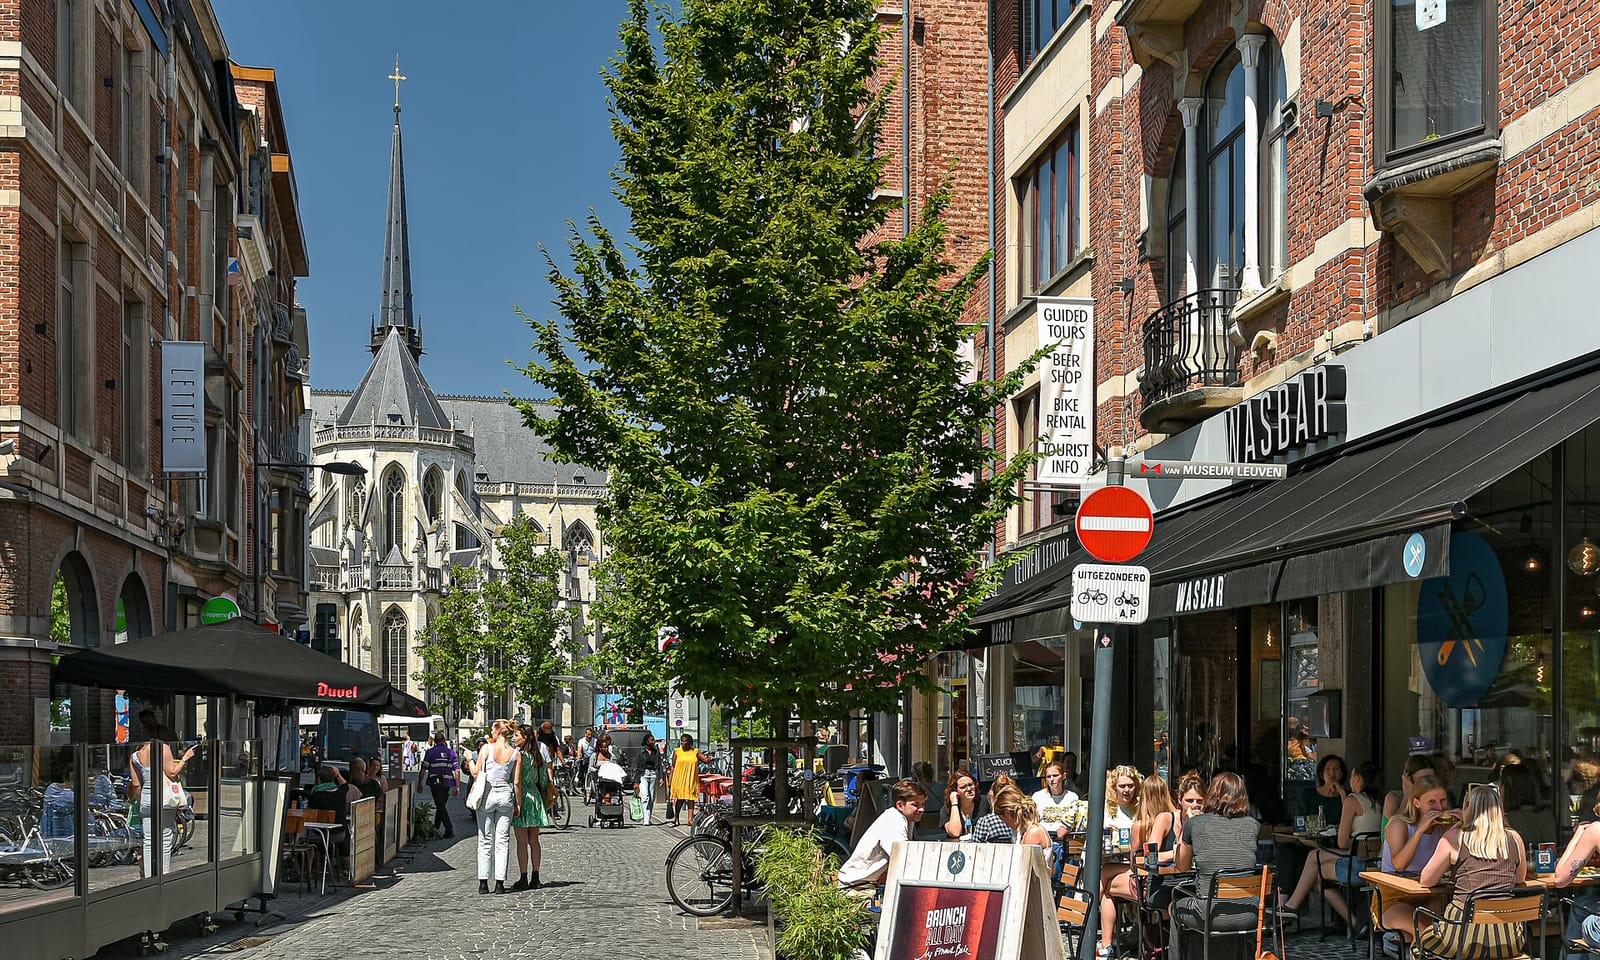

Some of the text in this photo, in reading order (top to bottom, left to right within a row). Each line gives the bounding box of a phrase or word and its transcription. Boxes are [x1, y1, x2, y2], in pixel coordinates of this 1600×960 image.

[1043, 308, 1088, 323] GUIDED
[1047, 324, 1085, 339] TOURS
[1053, 353, 1080, 368] BEER
[1051, 369, 1082, 384] SHOP
[171, 369, 196, 443] LETTUCE
[1054, 397, 1079, 412] BIKE
[1046, 414, 1086, 429] RENTAL
[1223, 365, 1331, 463] WASBAR
[1043, 442, 1089, 457] TOURIST
[1052, 459, 1079, 474] INFO
[1164, 464, 1282, 477] VAN MUSEUM LEUVEN
[1078, 571, 1146, 583] UITGEZONDERD
[1175, 575, 1225, 612] WASBAR
[317, 681, 358, 698] Duvel
[926, 906, 967, 928] BRUNCH
[925, 924, 964, 946] ALL DAY
